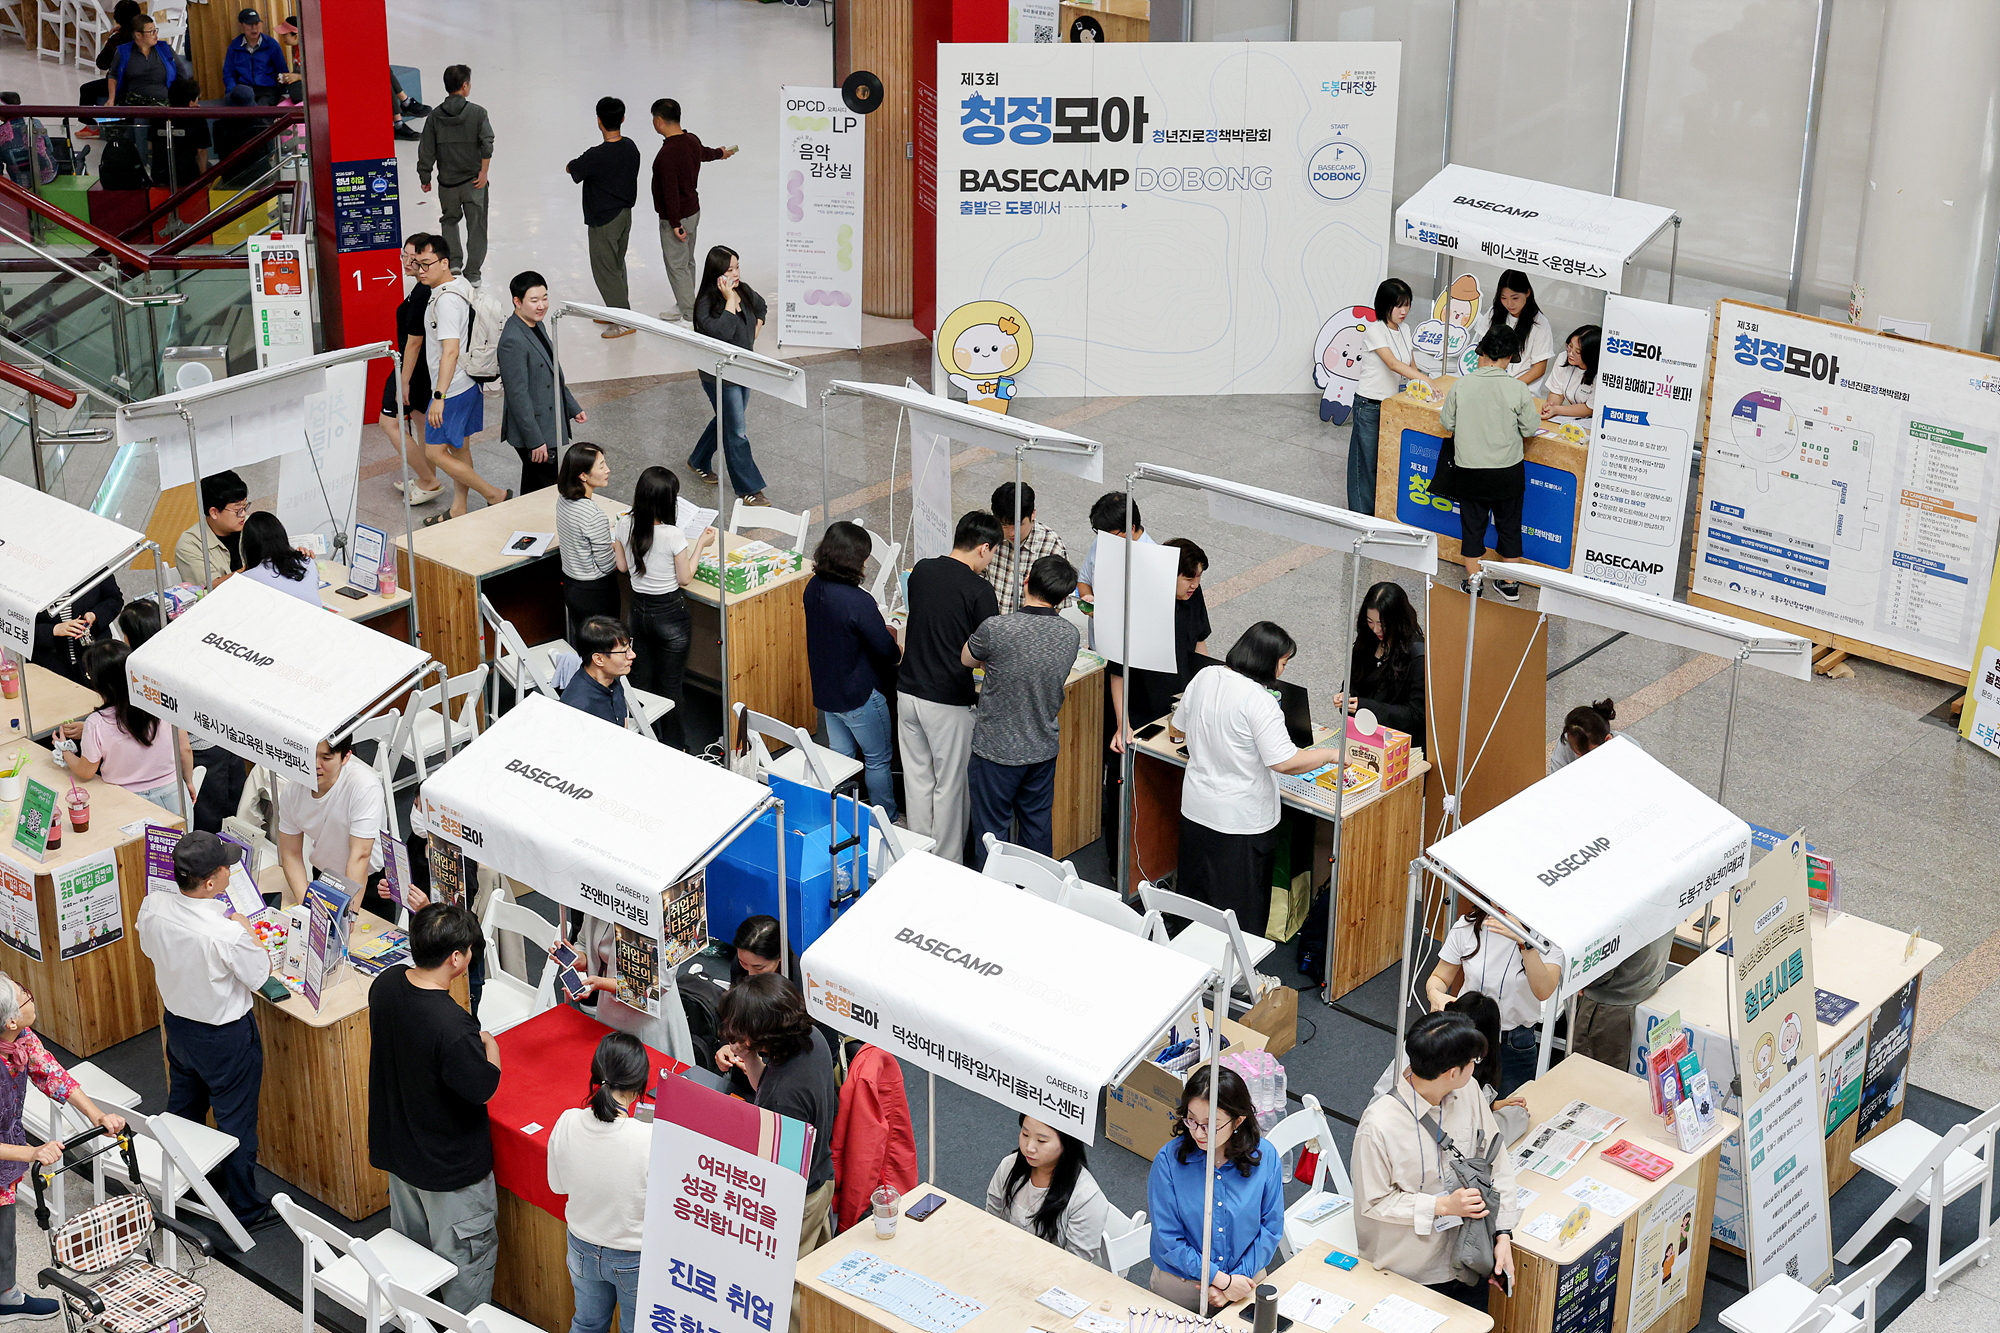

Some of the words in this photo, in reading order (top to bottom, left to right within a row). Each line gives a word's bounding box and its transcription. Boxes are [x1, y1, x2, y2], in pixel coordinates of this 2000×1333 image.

[961, 72, 999, 86] 제3회
[1321, 80, 1376, 97] 도봉대전환
[787, 100, 825, 112] OPCD
[833, 117, 857, 133] LP
[960, 91, 1149, 145] 청정모아
[1152, 129, 1271, 143] 청년진로정책박람회
[799, 143, 830, 160] 음악
[336, 177, 350, 185] 청년
[351, 176, 364, 184] 취업
[810, 163, 852, 179] 감상실
[960, 169, 1129, 192] BASECAMP
[1135, 166, 1272, 191] DOBONG
[1313, 171, 1361, 182] DOBONG
[960, 201, 1001, 215] 출발은
[1005, 201, 1061, 215] 도봉에서
[1453, 196, 1539, 220] BASECAMP
[1537, 213, 1610, 234] DOBONG
[1419, 229, 1459, 250] 청정모아
[268, 251, 293, 261] AED
[1481, 240, 1540, 265] 베이스캠프
[1542, 255, 1607, 279] <운영부스>
[353, 270, 362, 291] 1
[1737, 320, 1758, 332] 제3회
[1607, 336, 1662, 362] 청정모아
[1661, 358, 1697, 368] 청년진로정책박람회
[1734, 333, 1839, 385] 청정모아
[1840, 378, 1910, 401] 청년진로정책박람회
[1602, 373, 1624, 389] 박람회
[1625, 378, 1655, 395] 참여하고
[1656, 383, 1672, 398] 간식
[1673, 386, 1692, 402] 받자!
[1610, 410, 1623, 420] 참여
[1625, 413, 1639, 423] 방법
[1918, 424, 1935, 432] POLICY
[1628, 439, 1639, 447] 참여
[1645, 442, 1656, 450] 도장
[1657, 444, 1667, 452] 받기
[1410, 462, 1428, 473] 제3회
[1618, 472, 1637, 481] 제안하기
[1628, 465, 1648, 475] 친구추가
[1531, 478, 1543, 487] 출발은
[1544, 481, 1562, 491] 도봉에서
[1600, 483, 1630, 496] 만족도조사는
[1631, 489, 1642, 498] 필수!
[1643, 491, 1672, 502] (운영부스로)
[1599, 492, 1609, 500] 도장
[1630, 498, 1646, 508] 채우면
[1719, 505, 1740, 516] 프로그램
[1597, 512, 1612, 521] 맛있게
[1623, 518, 1643, 528] 다회용기
[1644, 522, 1665, 532] 반납하기
[1598, 503, 1618, 512] 구청광장
[1619, 507, 1648, 518] 푸드트럭에서
[1649, 512, 1660, 520] 간식
[1660, 514, 1671, 523] 받기
[5, 542, 54, 571] DOBONG
[1585, 550, 1664, 575] BASECAMP
[1584, 562, 1647, 586] DOBONG
[1743, 586, 1765, 598] 도봉구
[8, 609, 25, 622] CAREER
[25, 617, 31, 625] 10
[14, 625, 29, 645] 도봉
[201, 632, 274, 668] BASECAMP
[267, 661, 332, 694] DOBONG
[142, 683, 178, 714] 청정모아
[1981, 689, 1992, 700] 문의
[193, 710, 220, 735] 서울시
[219, 720, 264, 756] 기술교육원
[264, 742, 310, 776] 북부캠퍼스
[282, 737, 305, 753] CAREER
[304, 746, 309, 754] 11
[504, 758, 593, 802] BASECAMP
[440, 812, 484, 849] 청정모아
[433, 850, 457, 874] 취업과
[1536, 836, 1612, 887] BASECAMP
[1723, 843, 1740, 861] POLICY
[60, 880, 72, 891] 20
[75, 874, 93, 886] 하반기
[433, 866, 458, 887] 타로의
[1677, 883, 1705, 910] 도봉구
[1704, 853, 1745, 891] 청년미래과
[62, 889, 73, 900] 26
[616, 883, 642, 901] CAREER
[642, 893, 650, 903] 12
[580, 882, 649, 927] 쪼앤미컨설팅
[670, 891, 699, 918] 취업과
[671, 911, 700, 933] 타로의
[1757, 911, 1771, 929] 2026년
[1771, 902, 1784, 918] 도봉구
[676, 926, 695, 946] 만남
[1739, 912, 1805, 981] 청년성장프로젝트
[621, 944, 651, 966] 취업과
[894, 927, 1003, 979] BASECAMP
[1582, 935, 1621, 974] 청정모아
[622, 960, 651, 983] 타로의
[626, 976, 647, 994] 만남
[825, 979, 838, 989] 출발은
[838, 983, 856, 997] 도봉에서
[1745, 948, 1803, 1023] 청년새롬
[812, 995, 823, 1006] 제3회
[824, 990, 879, 1030] 청정모아
[1867, 1027, 1909, 1073] STAGE
[891, 1024, 945, 1063] 덕성여대
[947, 1048, 1086, 1126] 대학일자리플러스센터
[1046, 1075, 1077, 1096] CAREER
[1077, 1089, 1089, 1100] 13
[698, 1154, 766, 1198] 여러분의
[682, 1173, 718, 1204] 성공
[723, 1190, 778, 1230] 취업을
[1719, 1225, 1737, 1241] 20:00
[1560, 1277, 1574, 1297] 청년
[1574, 1266, 1589, 1285] 취업
[668, 1258, 718, 1303] 진로
[726, 1284, 774, 1331] 취업
